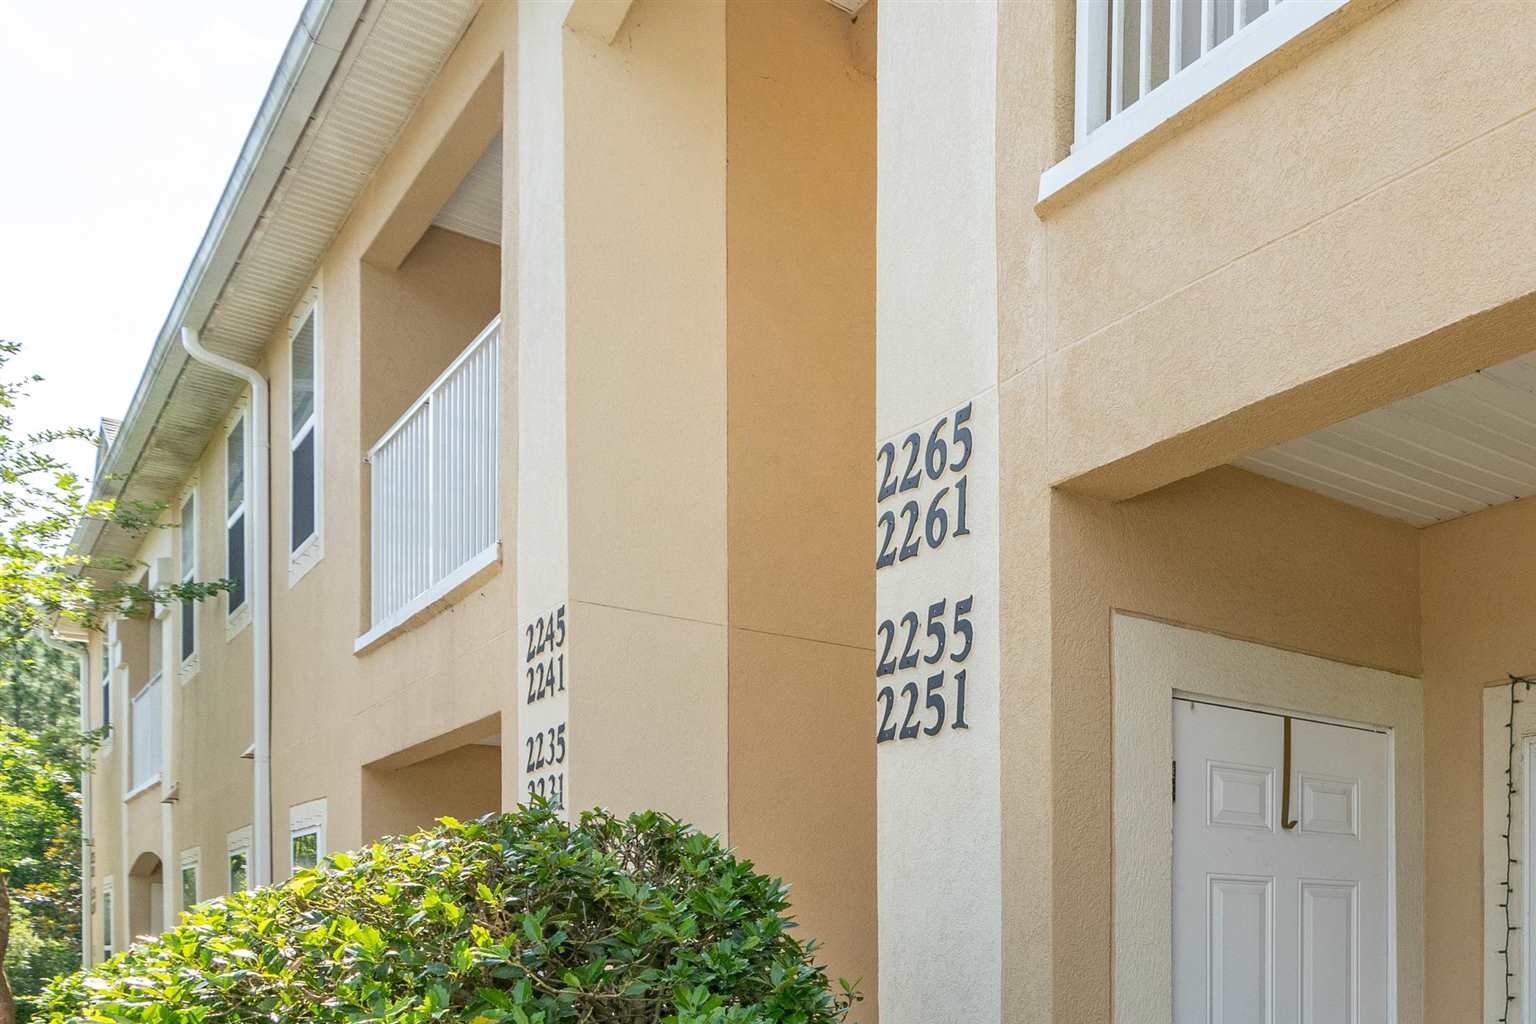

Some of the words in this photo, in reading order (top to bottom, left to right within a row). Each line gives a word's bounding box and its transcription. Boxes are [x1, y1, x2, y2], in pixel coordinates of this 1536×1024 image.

[877, 401, 972, 502] 2265
[876, 475, 970, 569] 2261
[526, 605, 565, 663] 2245
[876, 595, 973, 677] 2255
[527, 653, 565, 704] 2241
[877, 669, 969, 743] 2251
[526, 722, 565, 773] 2235
